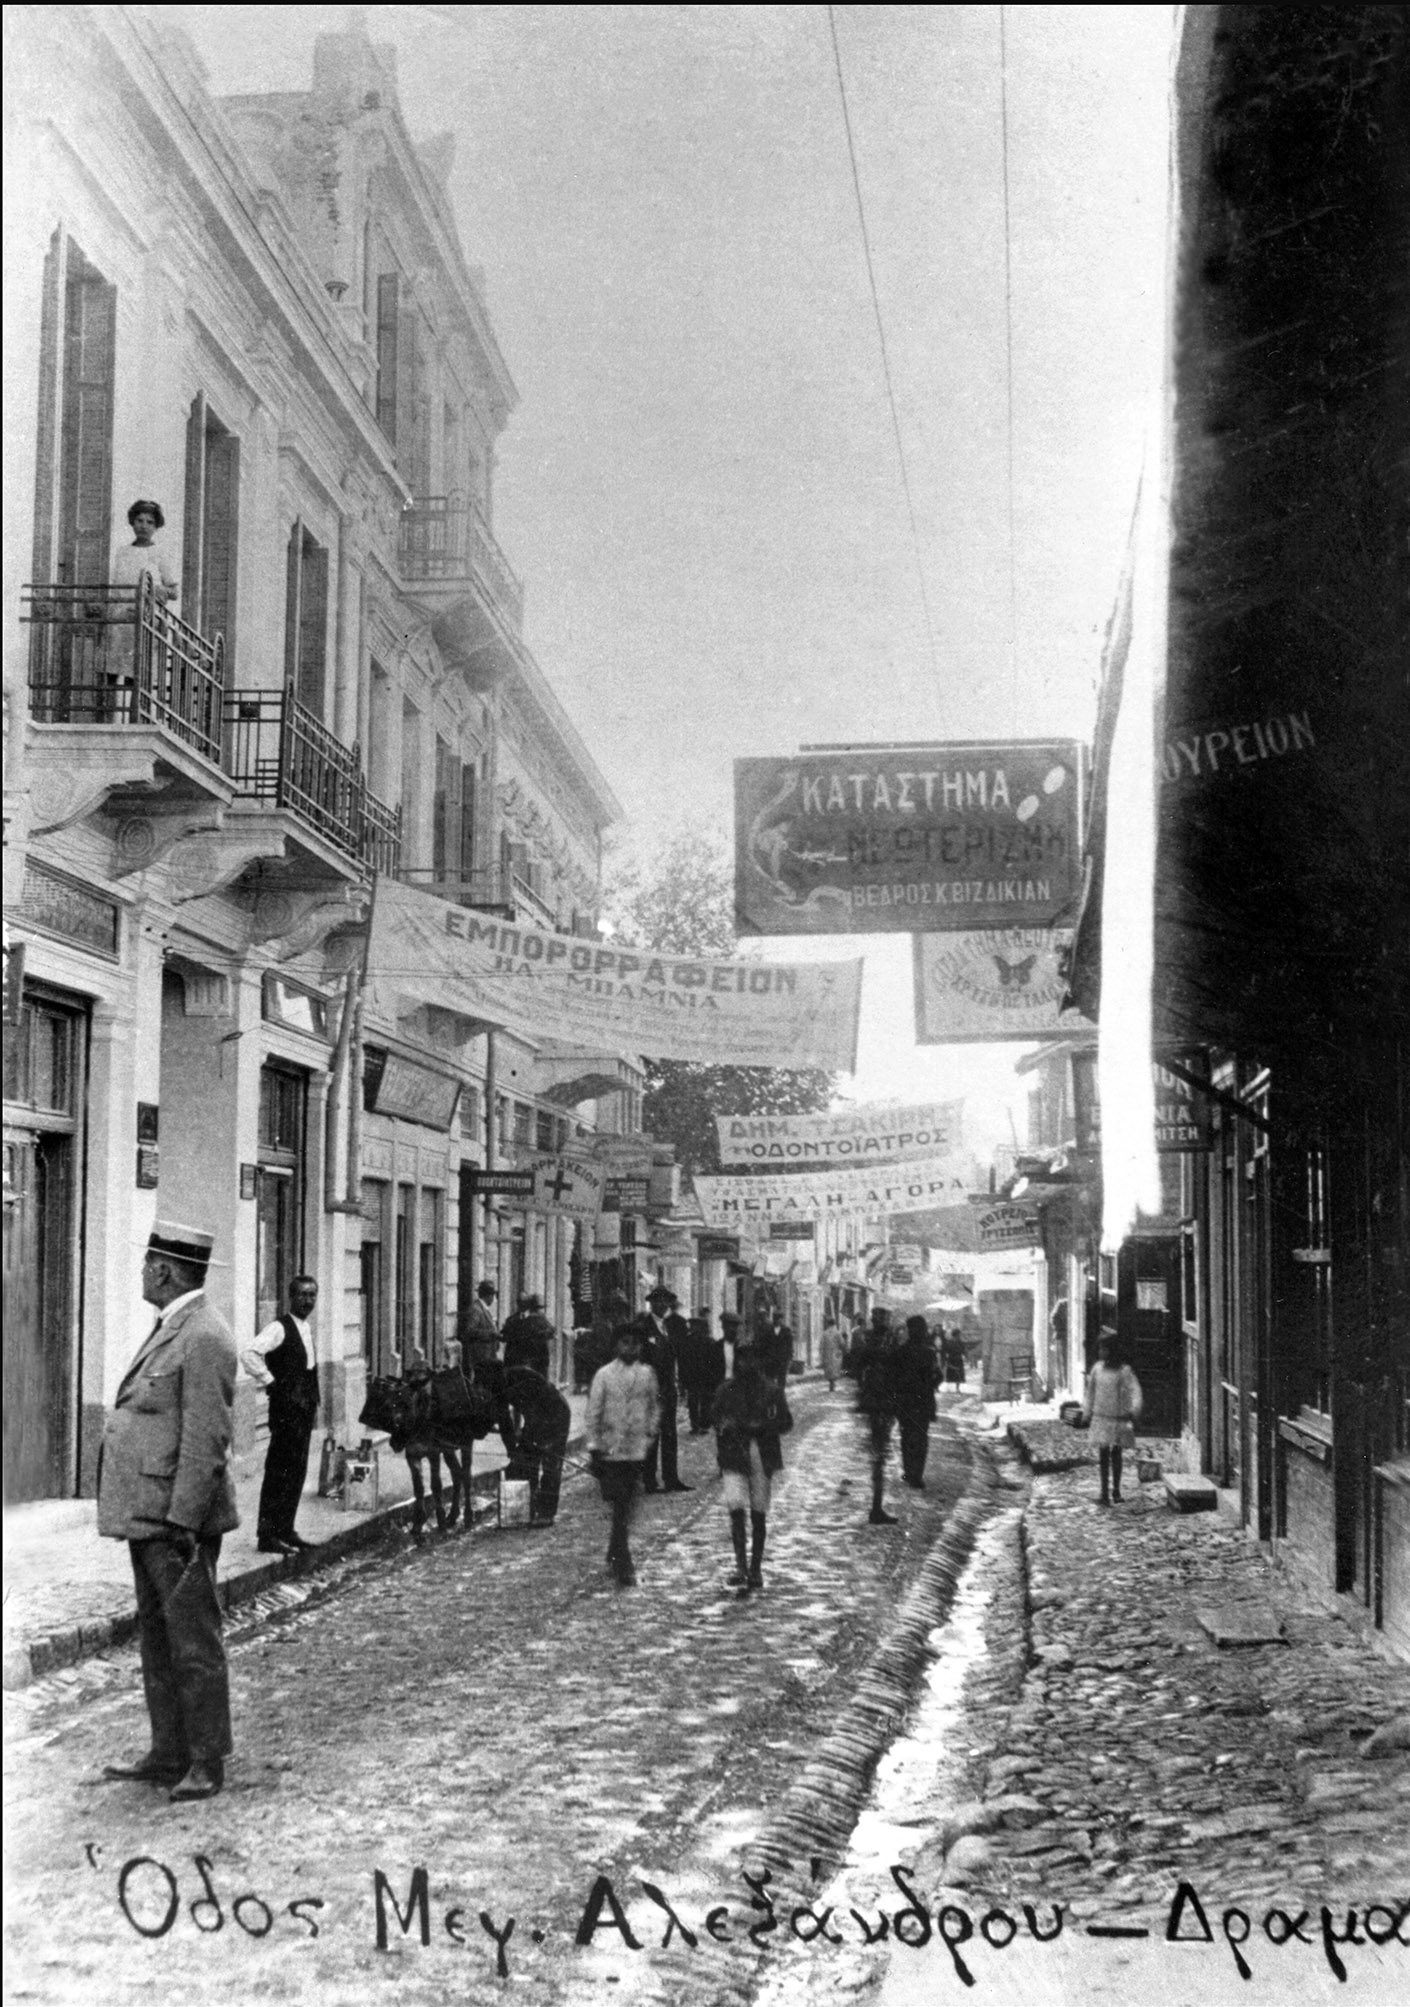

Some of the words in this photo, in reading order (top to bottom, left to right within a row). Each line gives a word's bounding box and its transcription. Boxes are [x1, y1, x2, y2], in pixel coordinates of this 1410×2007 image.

[801, 769, 1012, 815] ΚΑΤΑΣΤΗΜΑ
[445, 910, 798, 995] ΕΜΠΟΡΟΡΡΑΦΕΙΟΝ
[524, 1159, 600, 1189] ΑΡΜΑΚΕΙΟΝ
[979, 1208, 1033, 1228] ΚΟΥΡΕΙΟ
